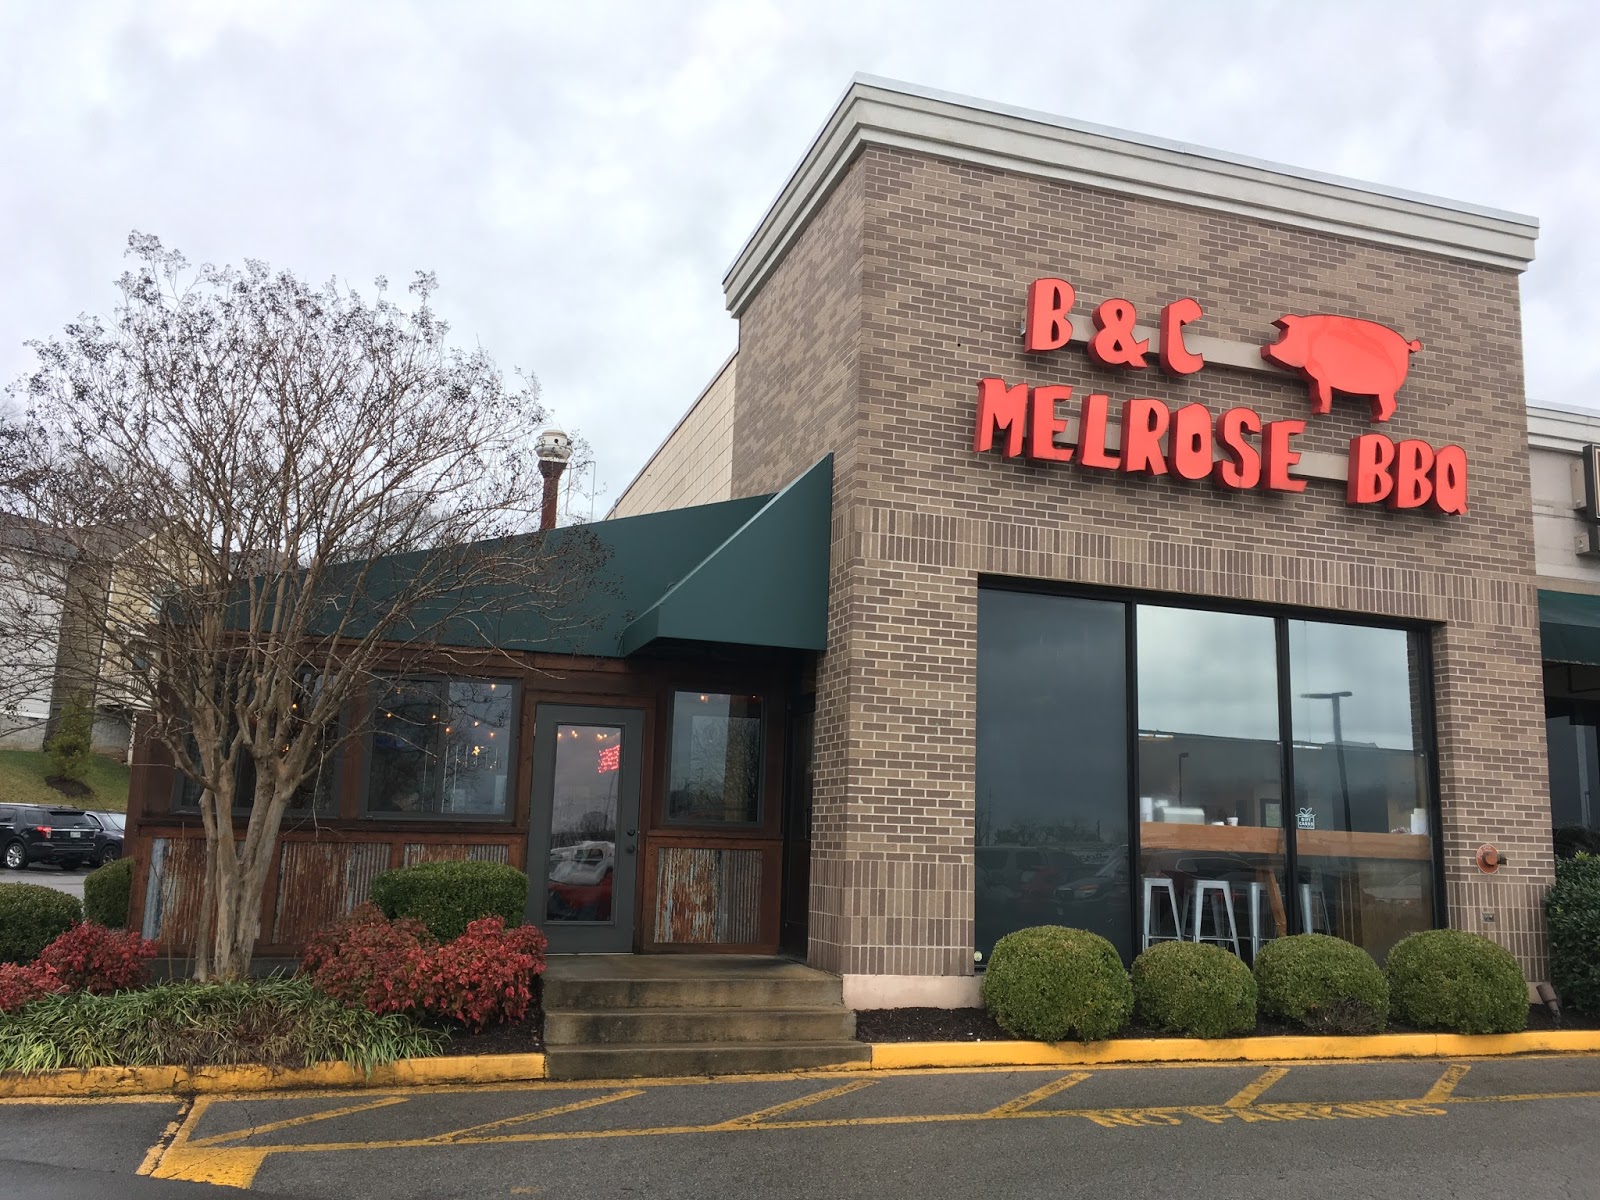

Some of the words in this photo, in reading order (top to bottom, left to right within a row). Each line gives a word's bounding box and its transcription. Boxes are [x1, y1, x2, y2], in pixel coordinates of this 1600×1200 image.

[973, 377, 1308, 494] MELROSE
[1347, 433, 1469, 516] BBQ
[1082, 1108, 1182, 1128] NO
[1185, 1102, 1448, 1123] PARKING
